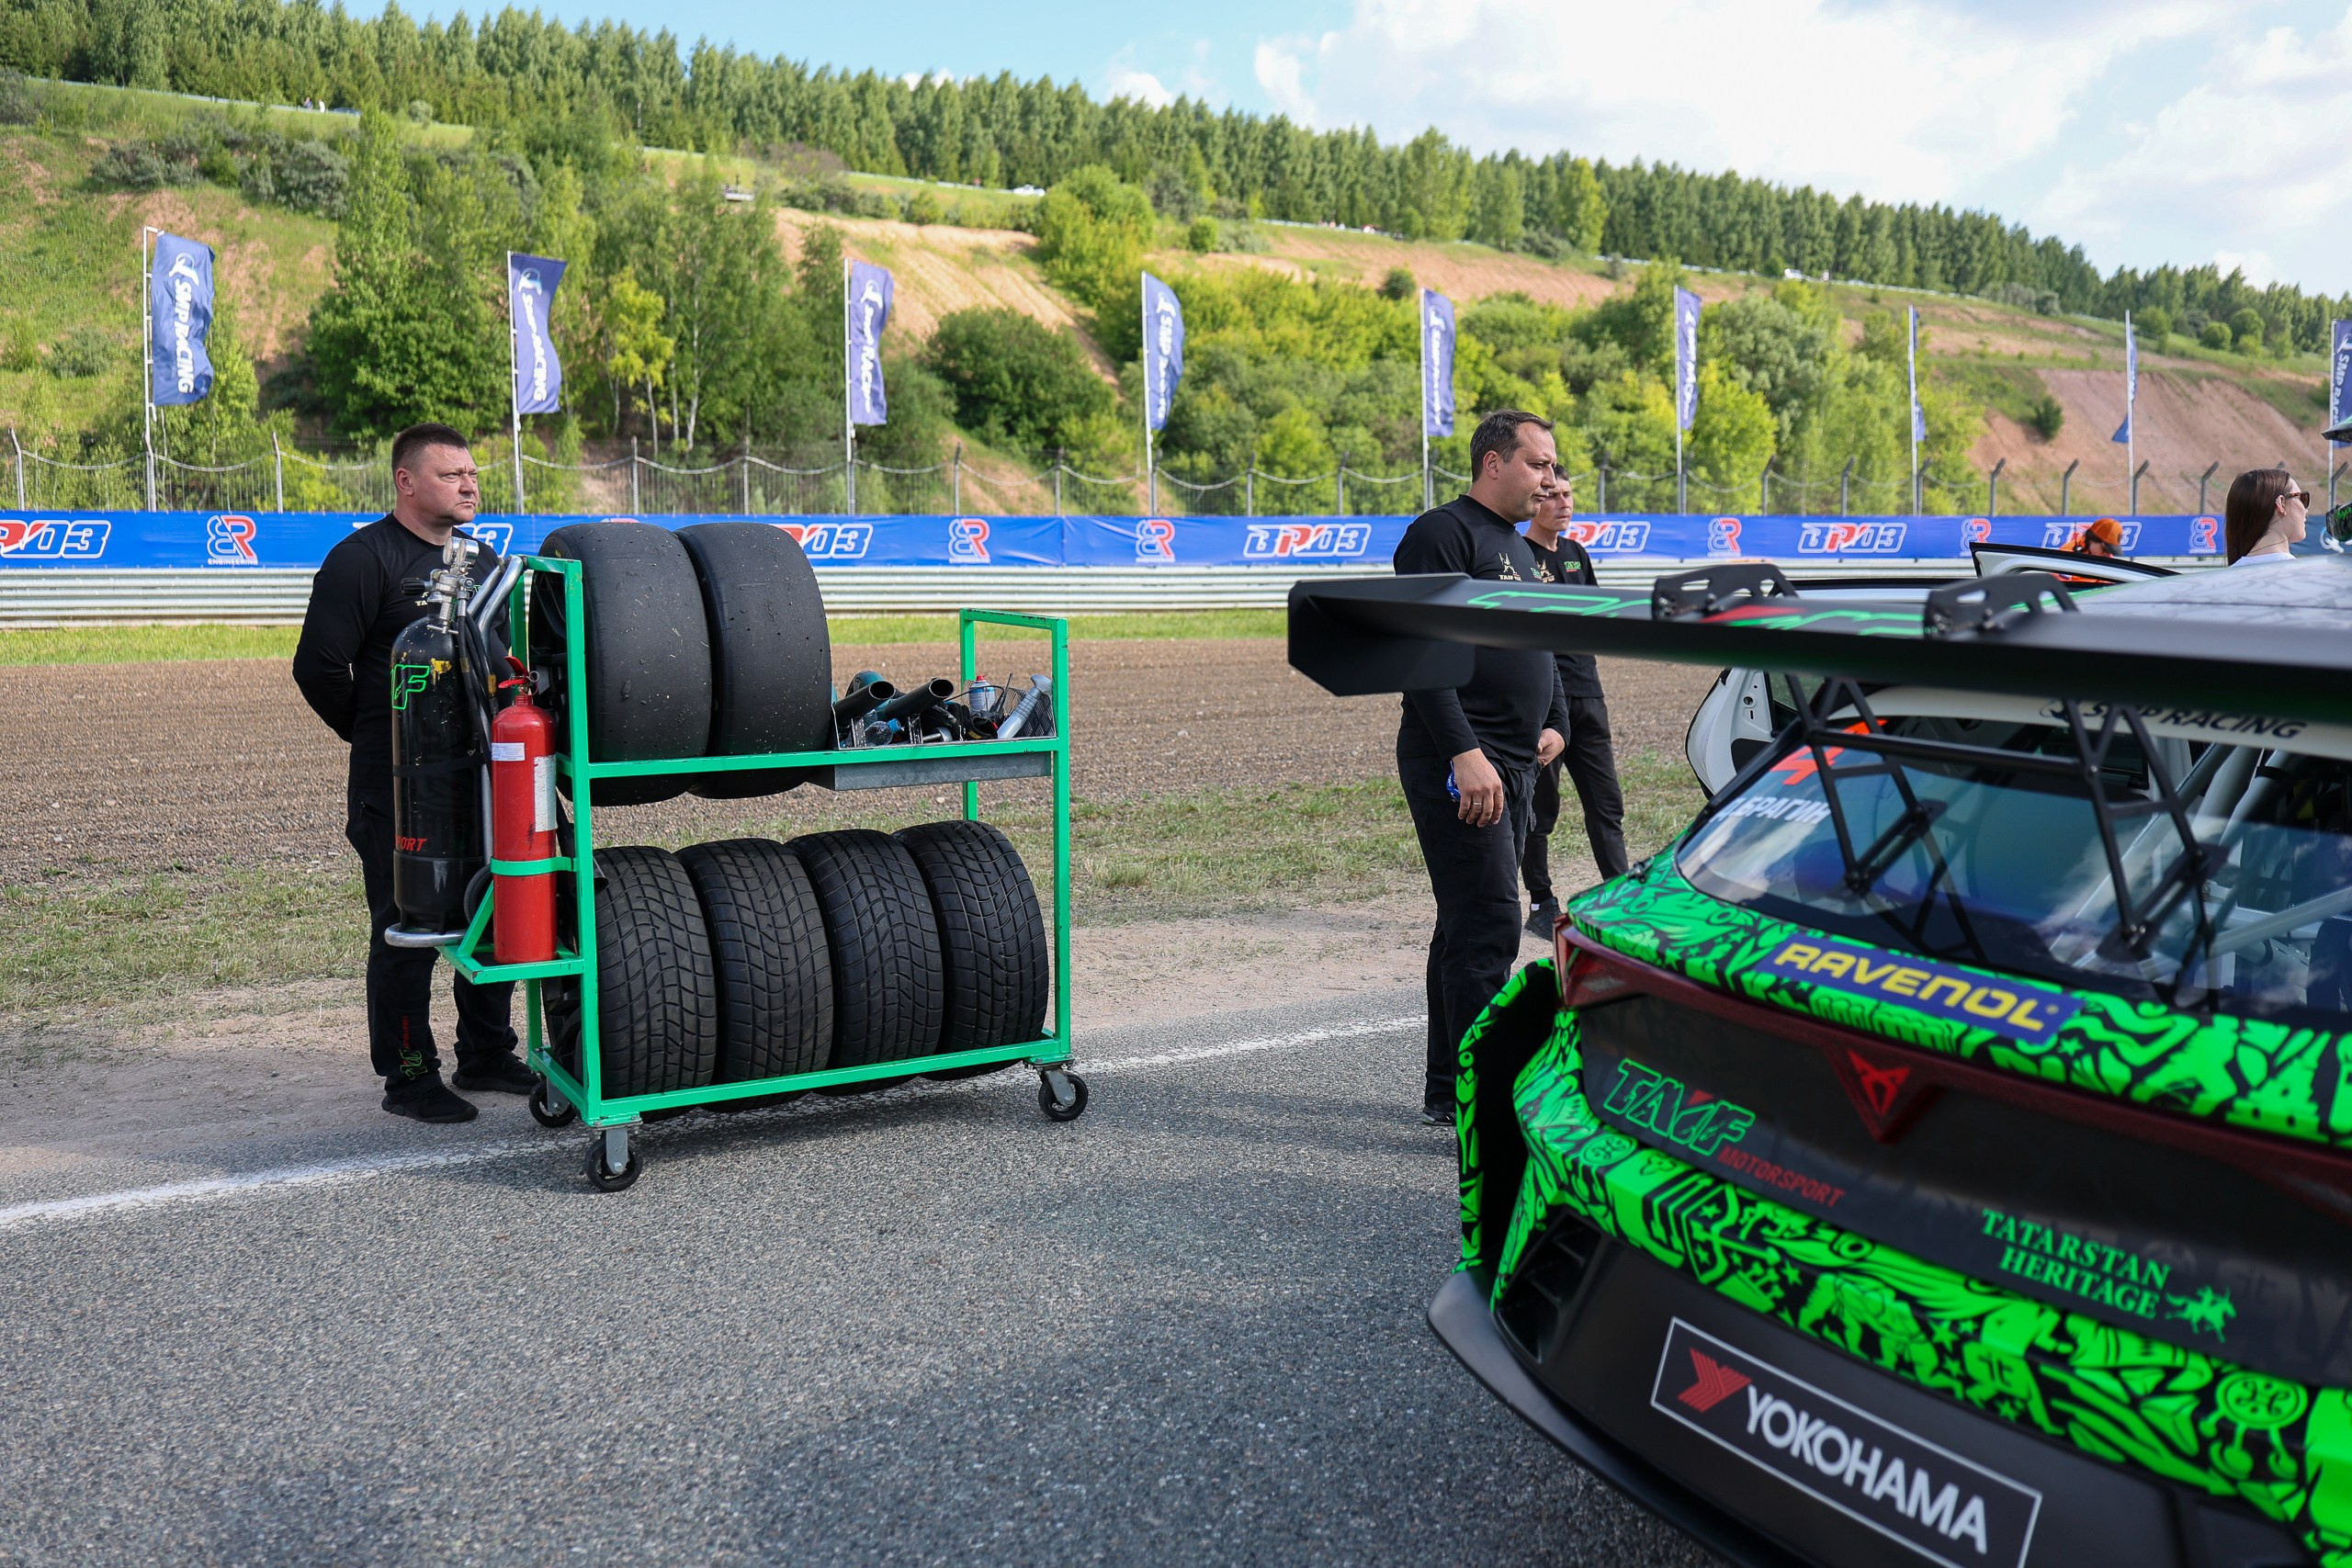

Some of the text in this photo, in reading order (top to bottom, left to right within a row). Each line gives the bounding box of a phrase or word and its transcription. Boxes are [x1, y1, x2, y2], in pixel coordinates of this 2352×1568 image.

[175, 278, 195, 393] SMP RACING
[2336, 354, 2349, 386] SMP
[2160, 708, 2308, 739] RACING
[1773, 942, 2044, 1032] RAVENOL
[1717, 1146, 1846, 1208] MOTORSPORT
[1983, 1208, 2171, 1291] TATARSTAN
[1999, 1246, 2160, 1319] HERITAGE
[1747, 1382, 1987, 1555] YOKOHAMA
